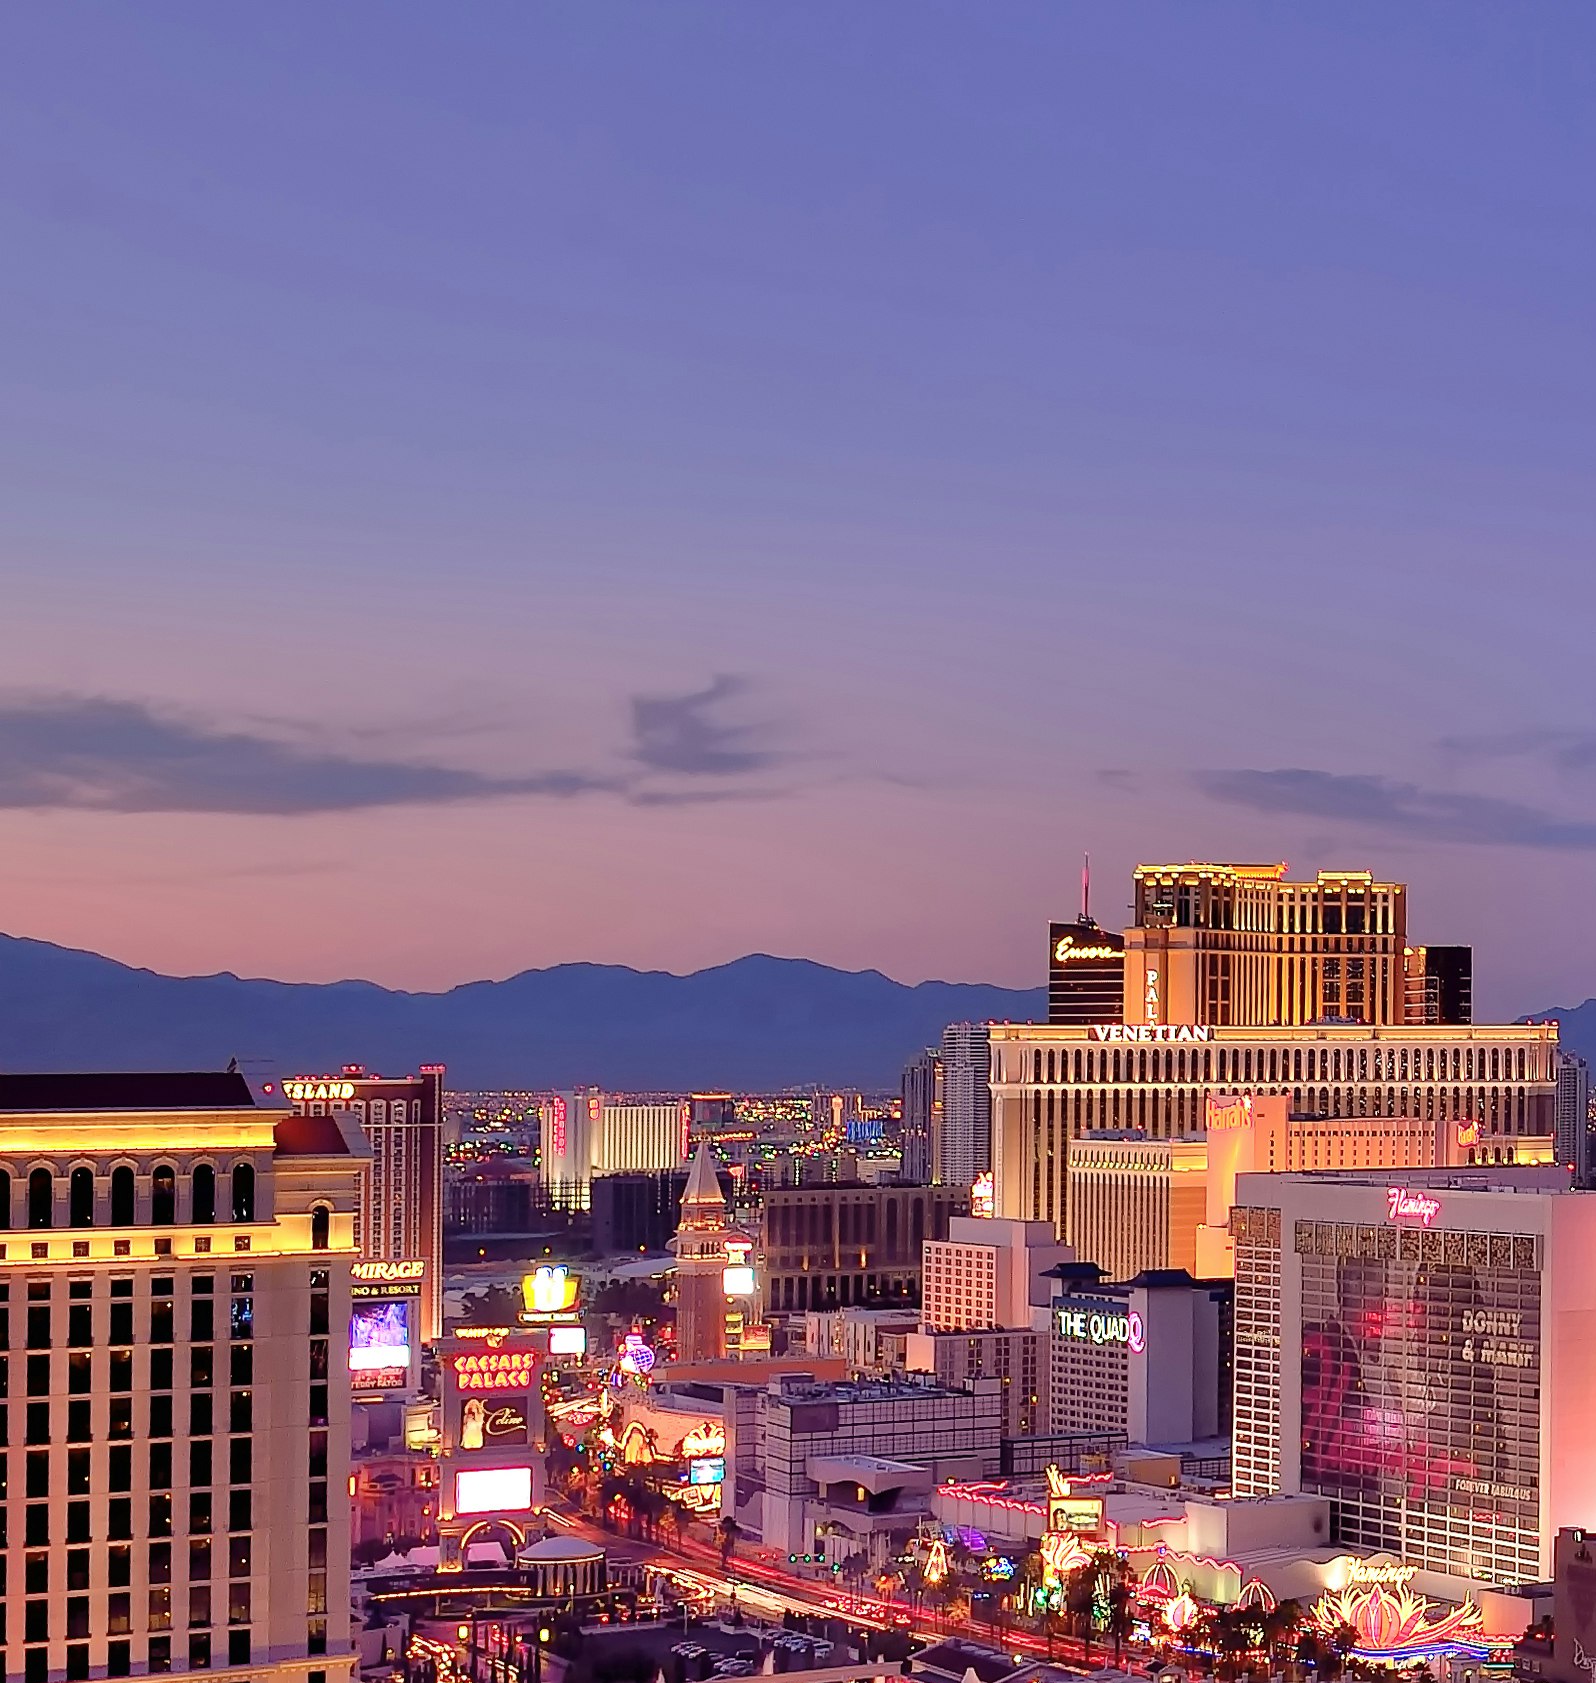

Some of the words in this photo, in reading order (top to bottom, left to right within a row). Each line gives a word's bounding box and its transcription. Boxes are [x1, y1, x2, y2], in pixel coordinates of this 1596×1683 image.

[1055, 936, 1127, 962] Encore
[1144, 969, 1158, 1026] PAL
[1094, 1025, 1210, 1042] VENETIAN
[1387, 1188, 1440, 1226] Flamingo
[351, 1261, 424, 1280] MIRAGE
[380, 1285, 420, 1295] RESORT
[1057, 1310, 1087, 1338] THE
[1088, 1314, 1129, 1344] QUAD
[454, 1353, 535, 1372] CAESARS
[458, 1370, 530, 1389] PALACE
[1455, 1479, 1490, 1495] FOREVER
[1347, 1556, 1418, 1585] Flamingo
